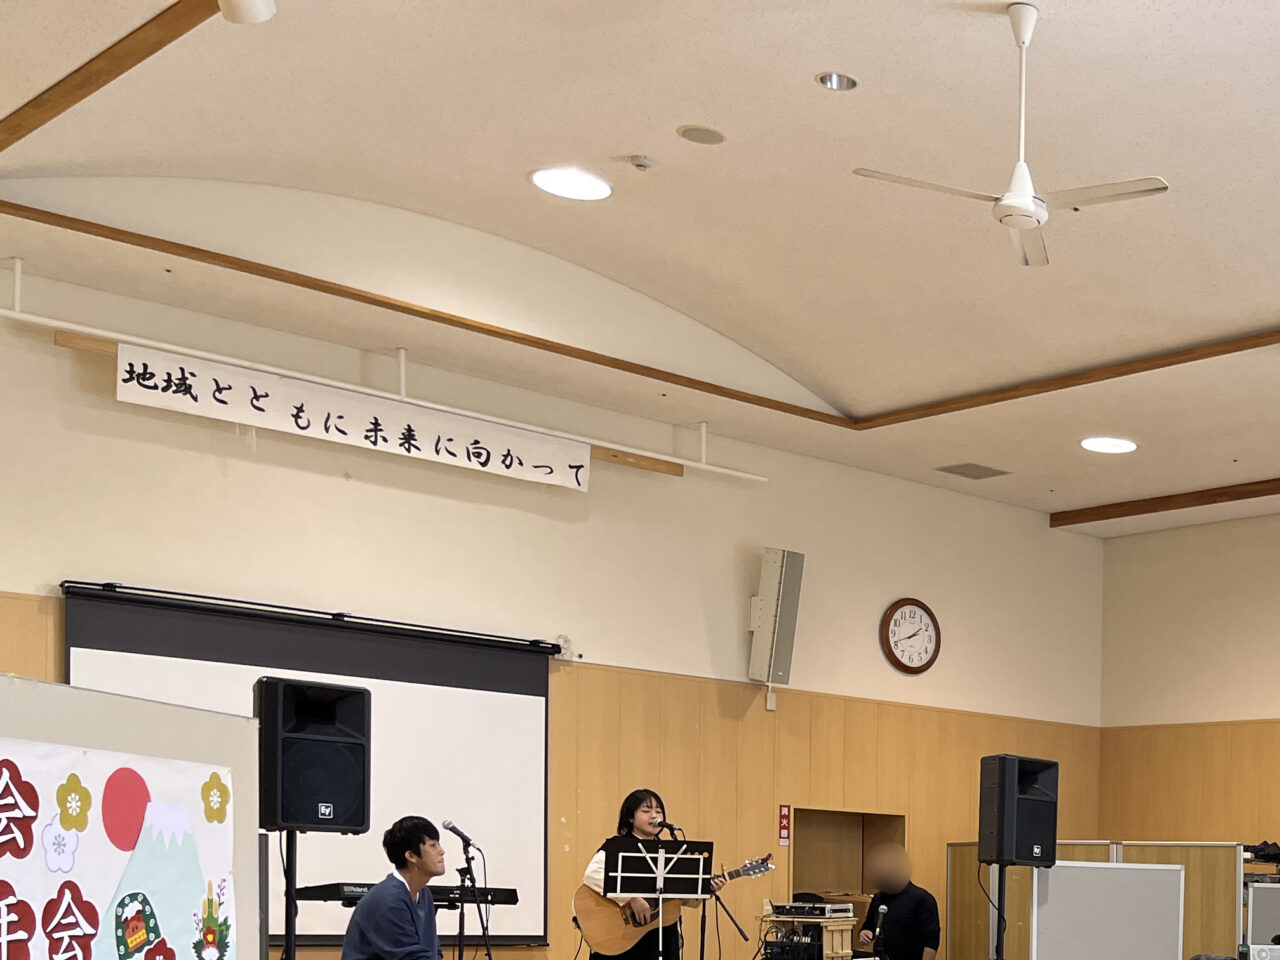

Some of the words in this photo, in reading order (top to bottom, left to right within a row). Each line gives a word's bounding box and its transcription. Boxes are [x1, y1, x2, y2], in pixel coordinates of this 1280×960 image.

[121, 362, 585, 487] 地域とともに未来に向かって
